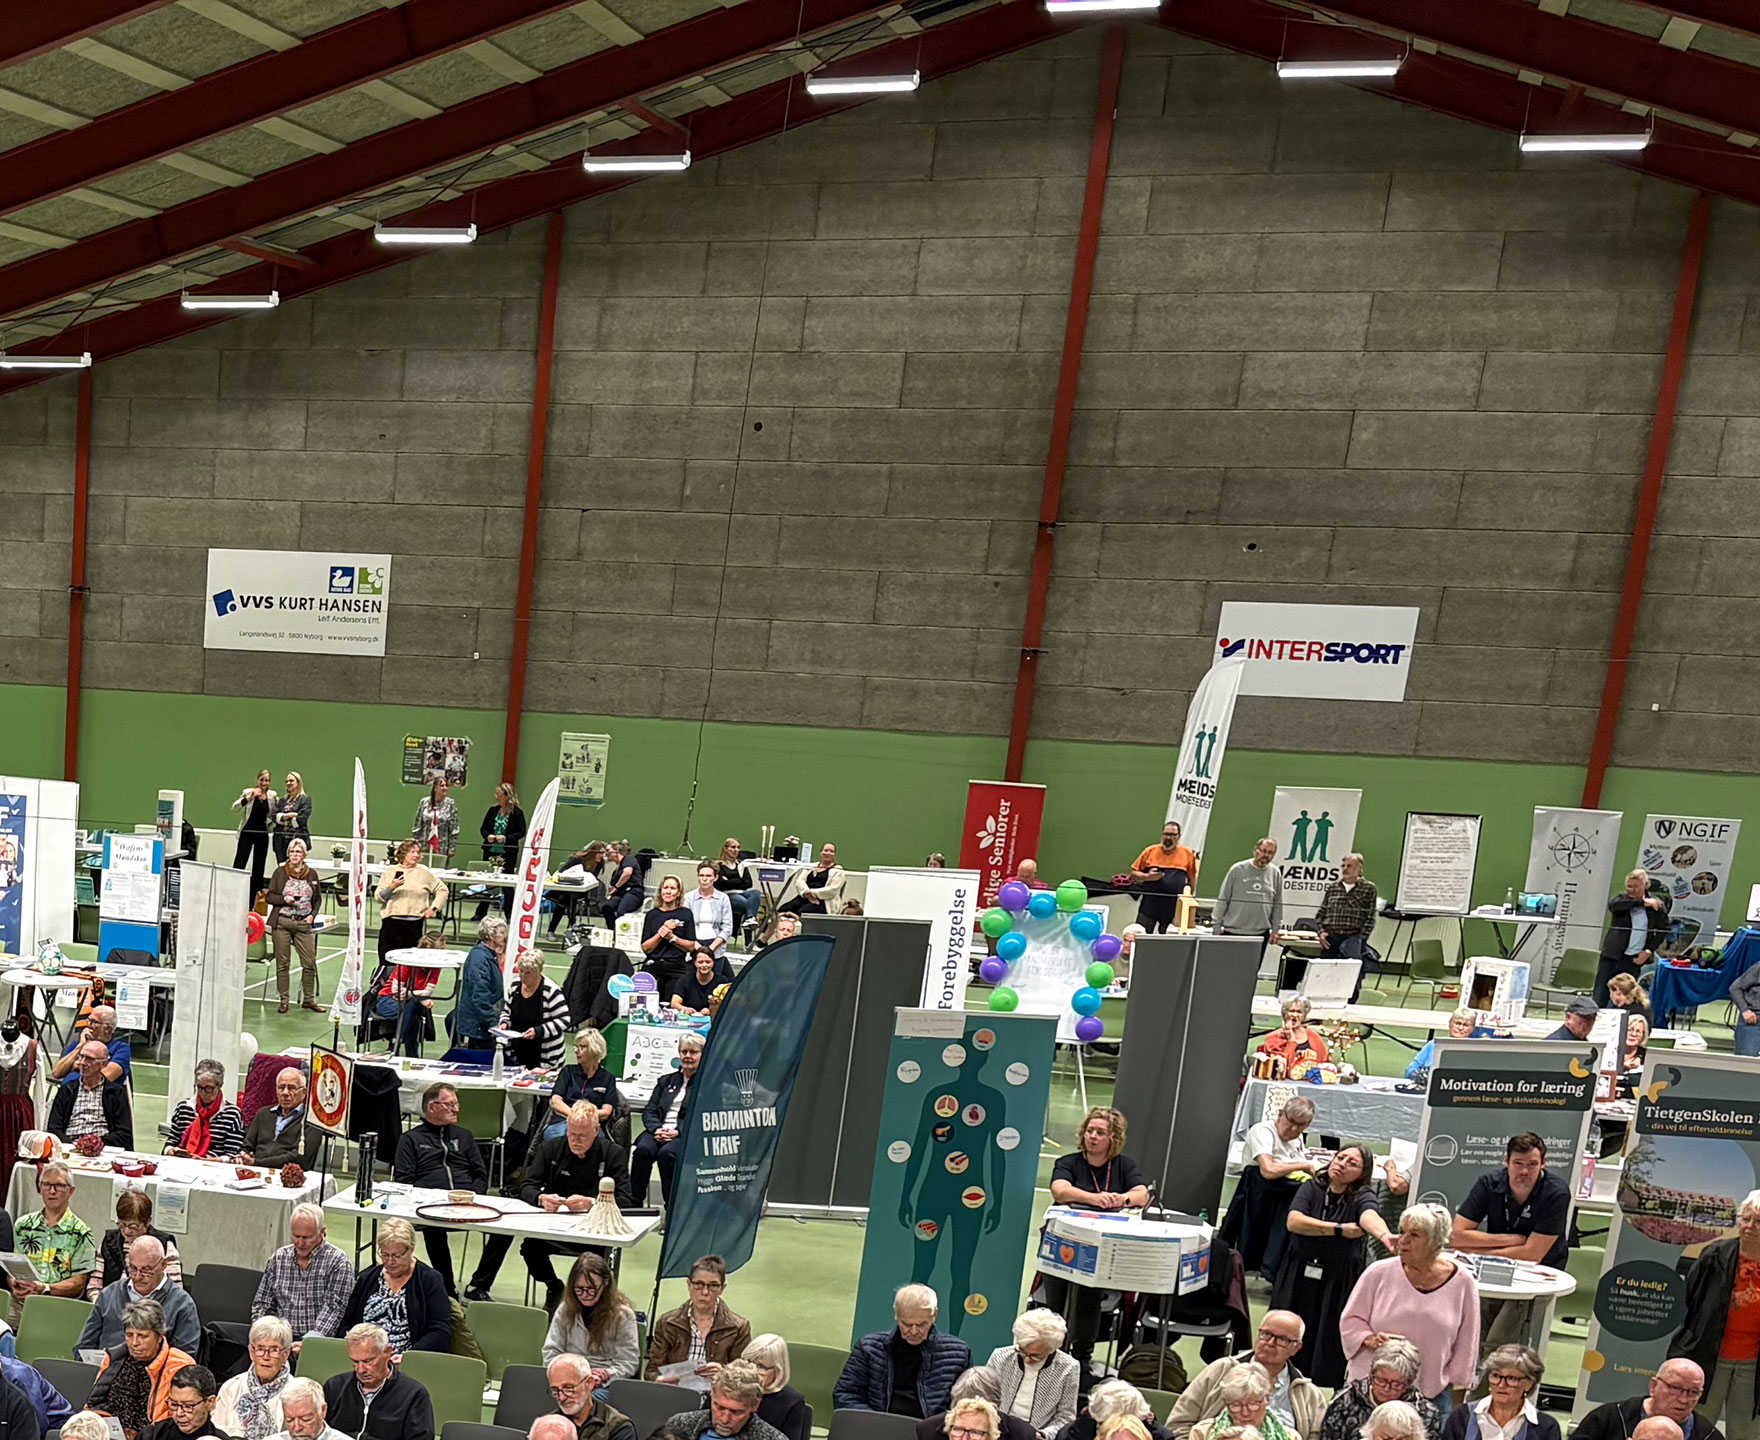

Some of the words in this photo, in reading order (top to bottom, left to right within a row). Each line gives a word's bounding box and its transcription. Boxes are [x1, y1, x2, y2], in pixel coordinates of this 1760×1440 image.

[239, 595, 274, 609] VVS
[279, 596, 315, 611] KURT
[318, 598, 383, 613] HANSEN
[1247, 638, 1407, 665] INTERSPORT
[988, 798, 1011, 866] Seniorer
[1679, 821, 1731, 838] NGIF
[938, 888, 967, 1010] Forebyggelse
[1439, 1077, 1514, 1093] Motivation
[1516, 1080, 1538, 1094] for
[1539, 1080, 1586, 1097] læring
[701, 1106, 777, 1132] BADMINTON
[1644, 1106, 1754, 1124] TietgenSkolen
[703, 1137, 709, 1157] I
[712, 1135, 741, 1156] KRIF
